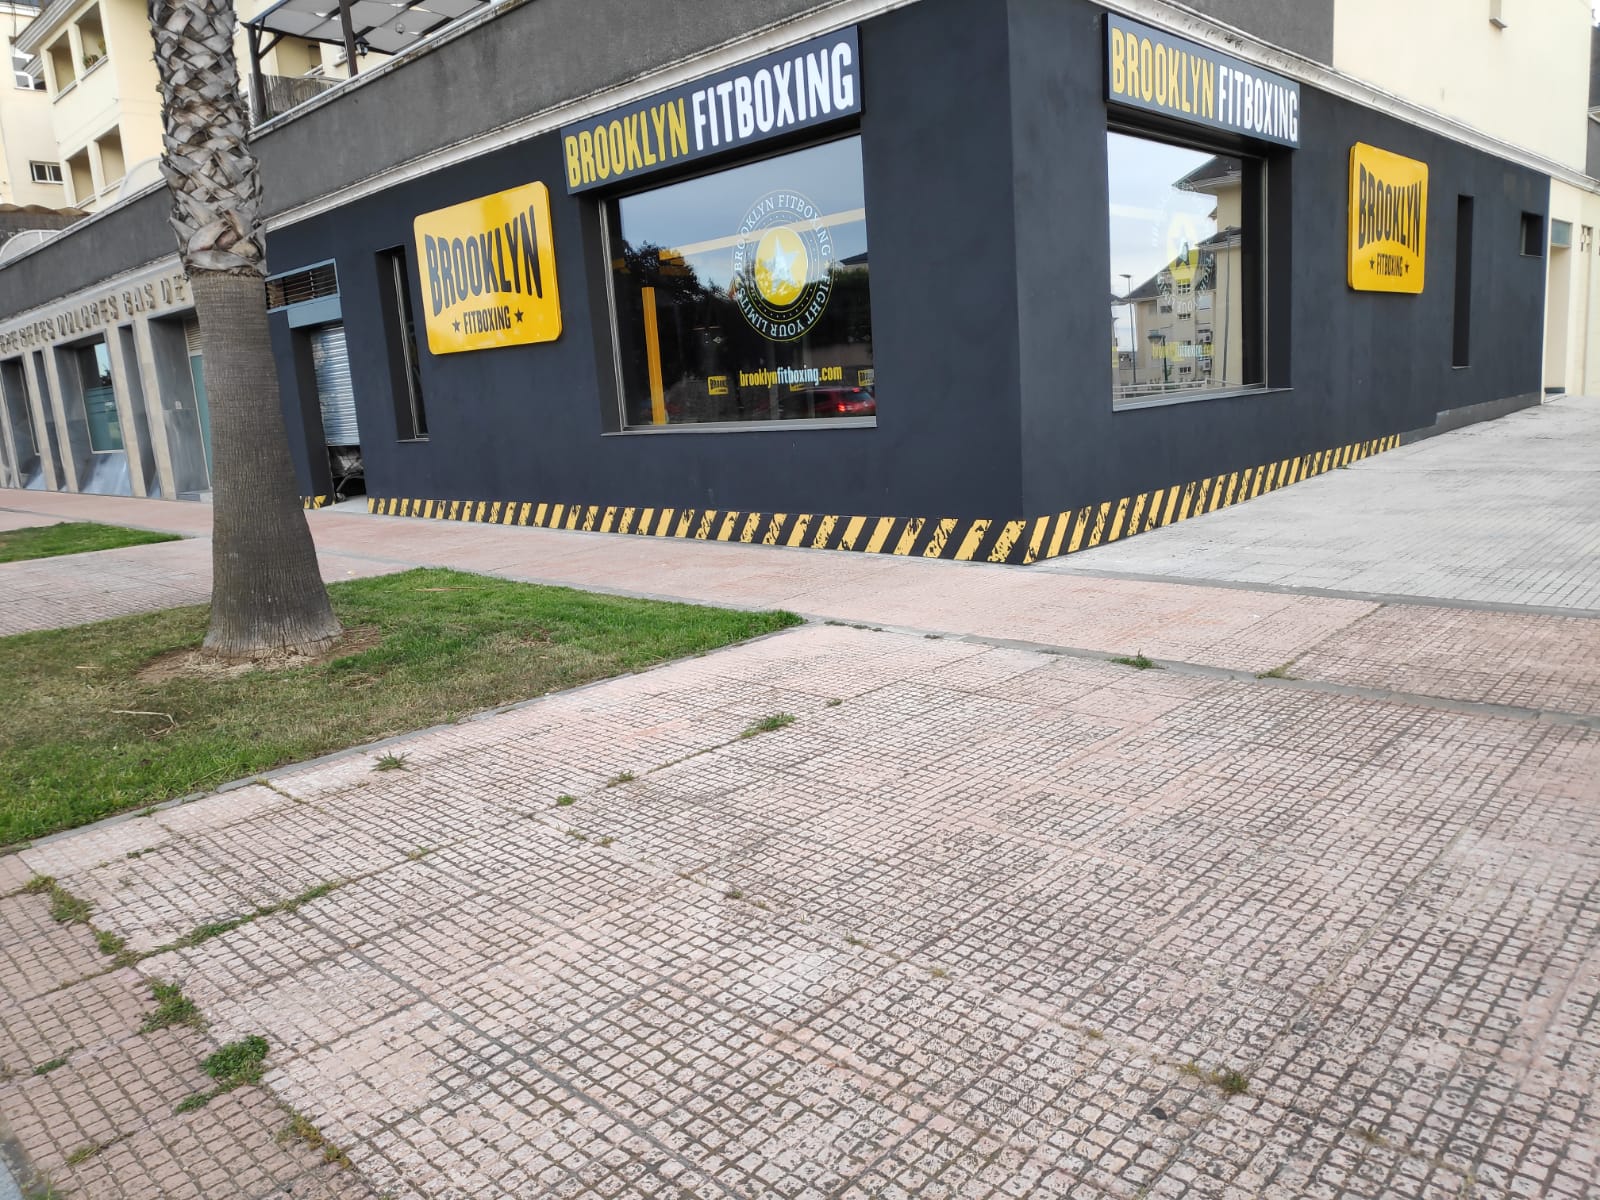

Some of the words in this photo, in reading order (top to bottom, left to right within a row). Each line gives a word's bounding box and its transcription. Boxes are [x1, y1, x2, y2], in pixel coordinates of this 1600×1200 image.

[1111, 27, 1214, 120] BROOKLYN
[1218, 65, 1298, 143] FITBOXING
[564, 98, 689, 188] BROOKLYN
[692, 42, 854, 151] FITBOXING
[734, 197, 774, 271] BROOKLYN
[778, 194, 831, 257] FITBOXING
[1358, 162, 1422, 258] BROOKLYN
[424, 205, 543, 317] BROOKLYN
[1376, 253, 1403, 277] FITBOXING
[57, 294, 119, 337] DOLORES
[160, 274, 185, 305] DE
[463, 305, 511, 334] FITBOXING
[736, 287, 767, 332] LIMITS
[771, 319, 805, 337] YOUR
[805, 275, 831, 326] FIGHT
[739, 364, 843, 389] brooklynfitboxing.com
